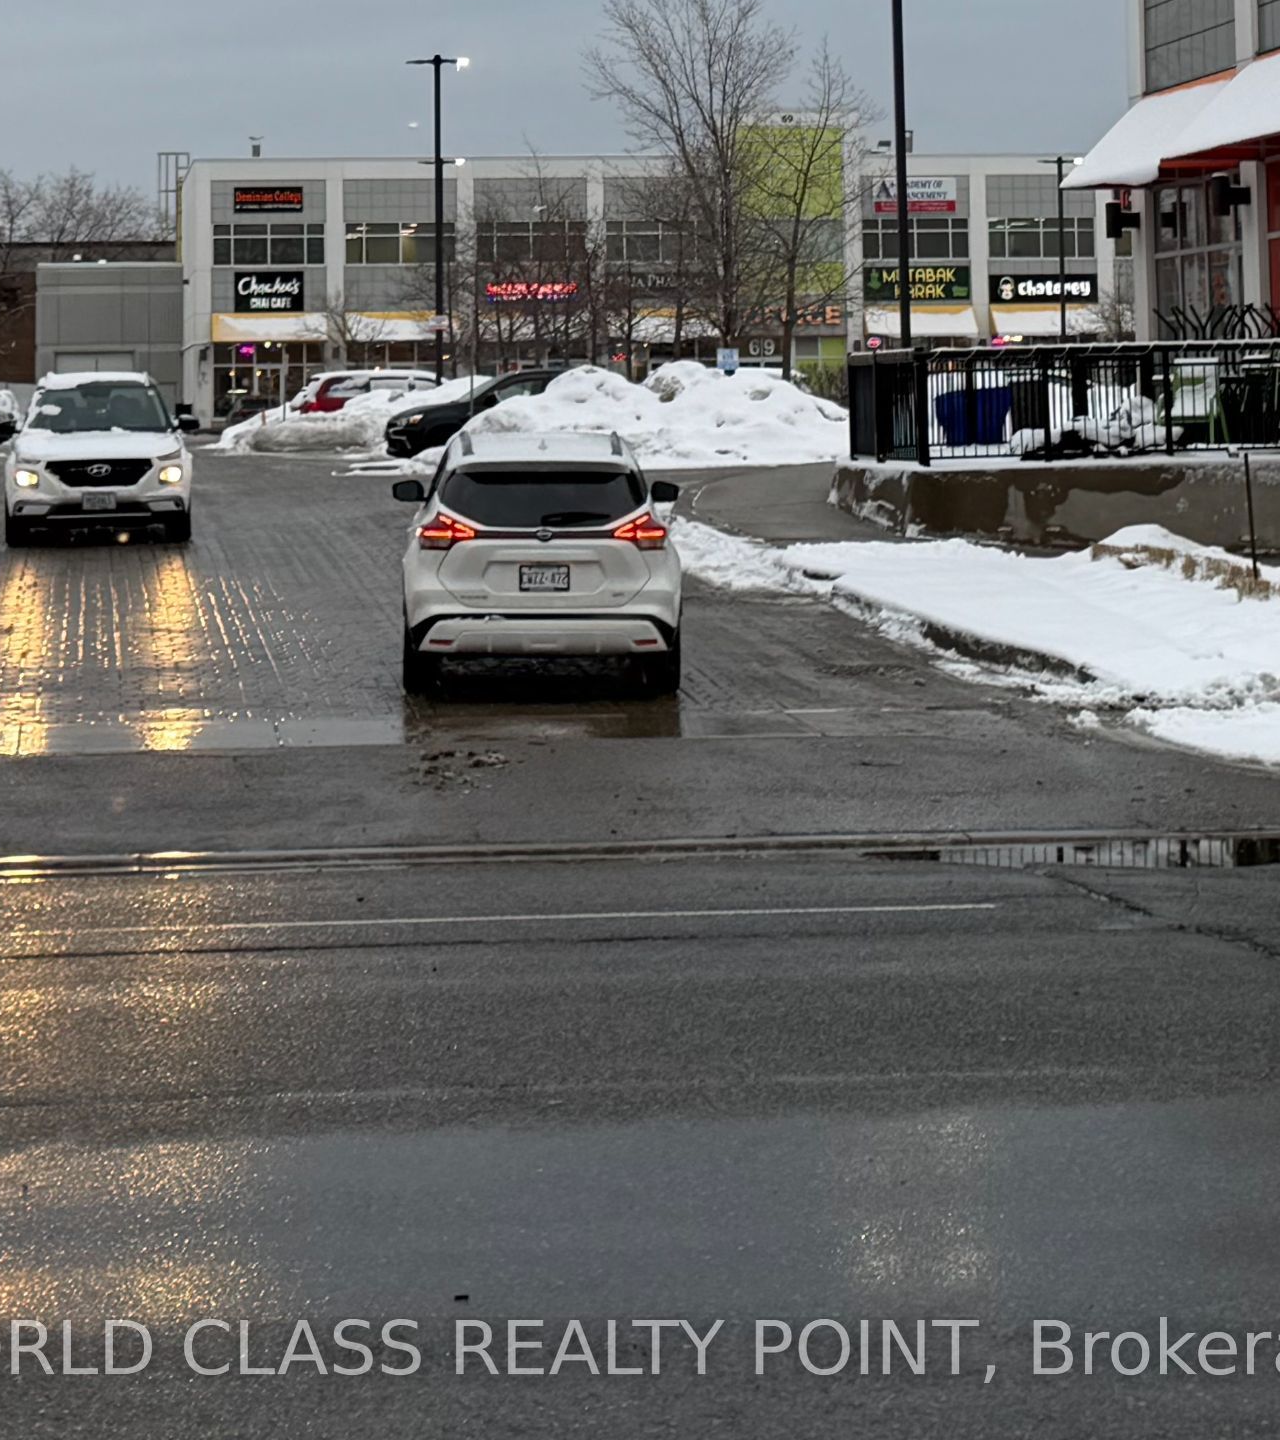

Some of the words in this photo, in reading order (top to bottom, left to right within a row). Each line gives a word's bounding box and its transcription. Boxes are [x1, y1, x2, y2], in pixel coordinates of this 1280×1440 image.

[250, 297, 270, 309] CHAI
[271, 297, 292, 309] CAFE
[748, 338, 776, 356] 69
